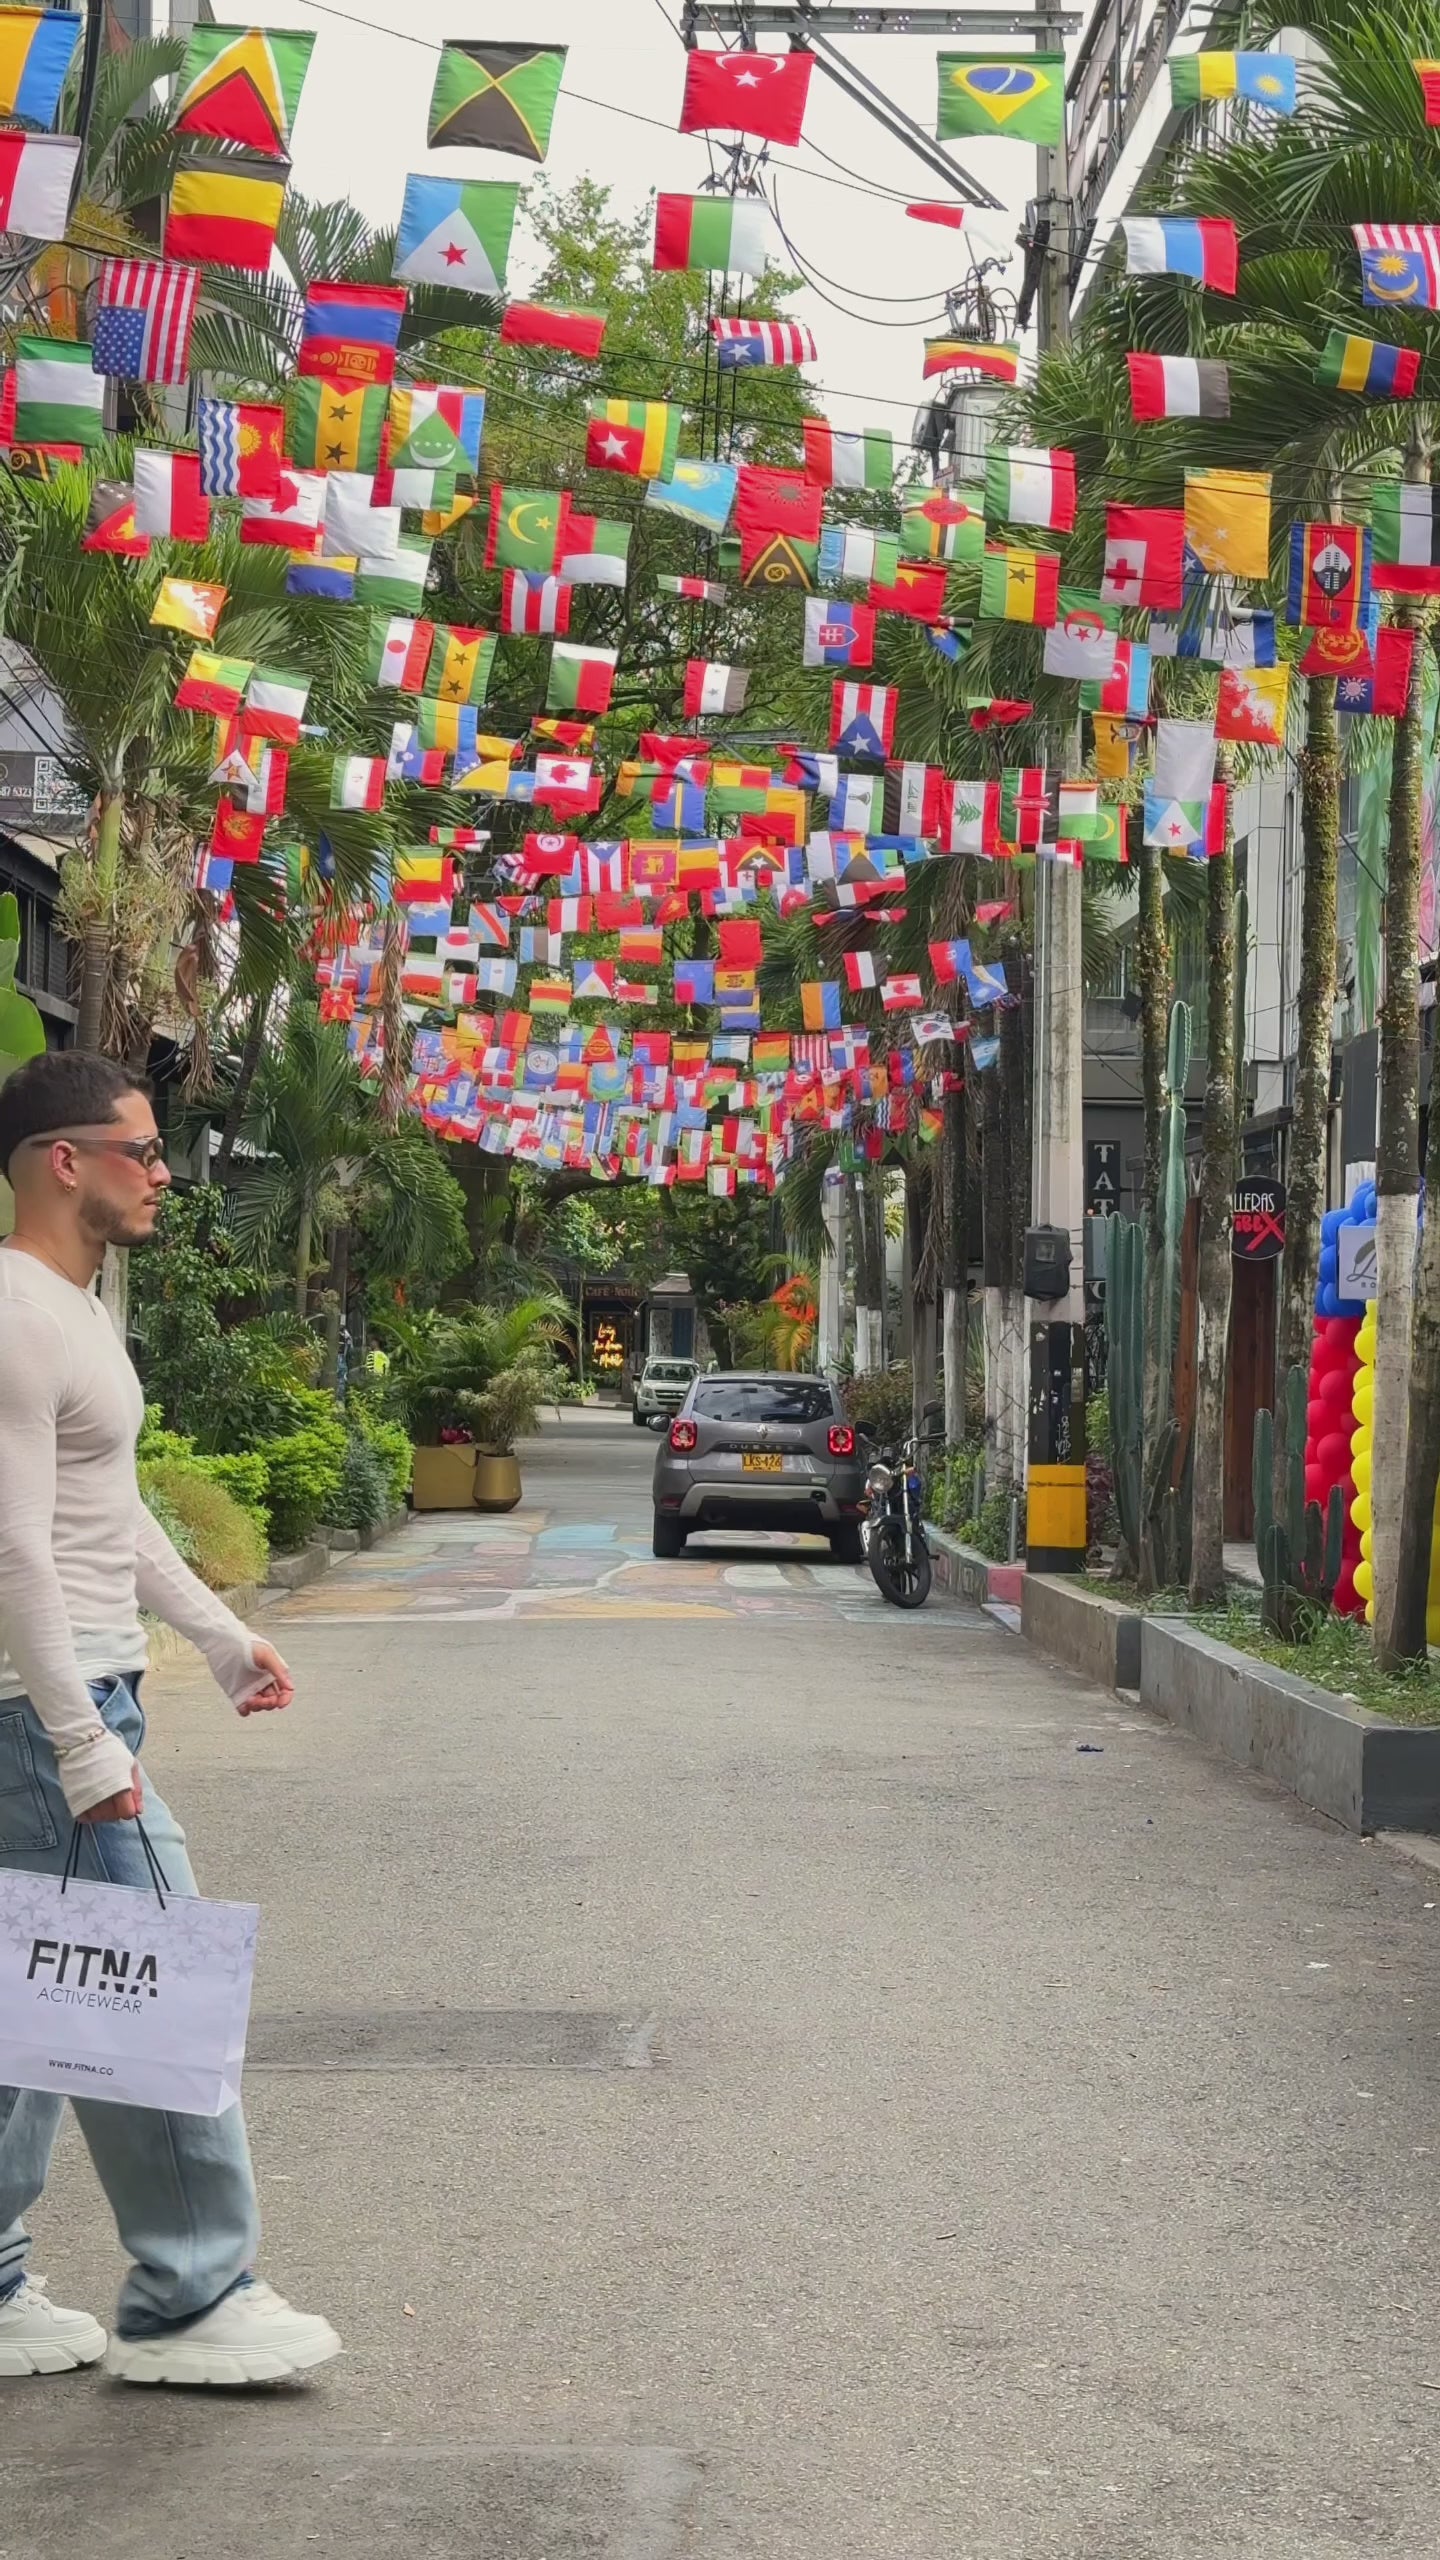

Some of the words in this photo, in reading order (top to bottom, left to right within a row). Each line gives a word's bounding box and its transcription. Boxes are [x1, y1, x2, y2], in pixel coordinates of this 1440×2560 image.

[1234, 1192, 1275, 1213] LLERAS
[26, 1938, 158, 1998] FITNA
[36, 1986, 143, 2015] ACTIVEWEAR
